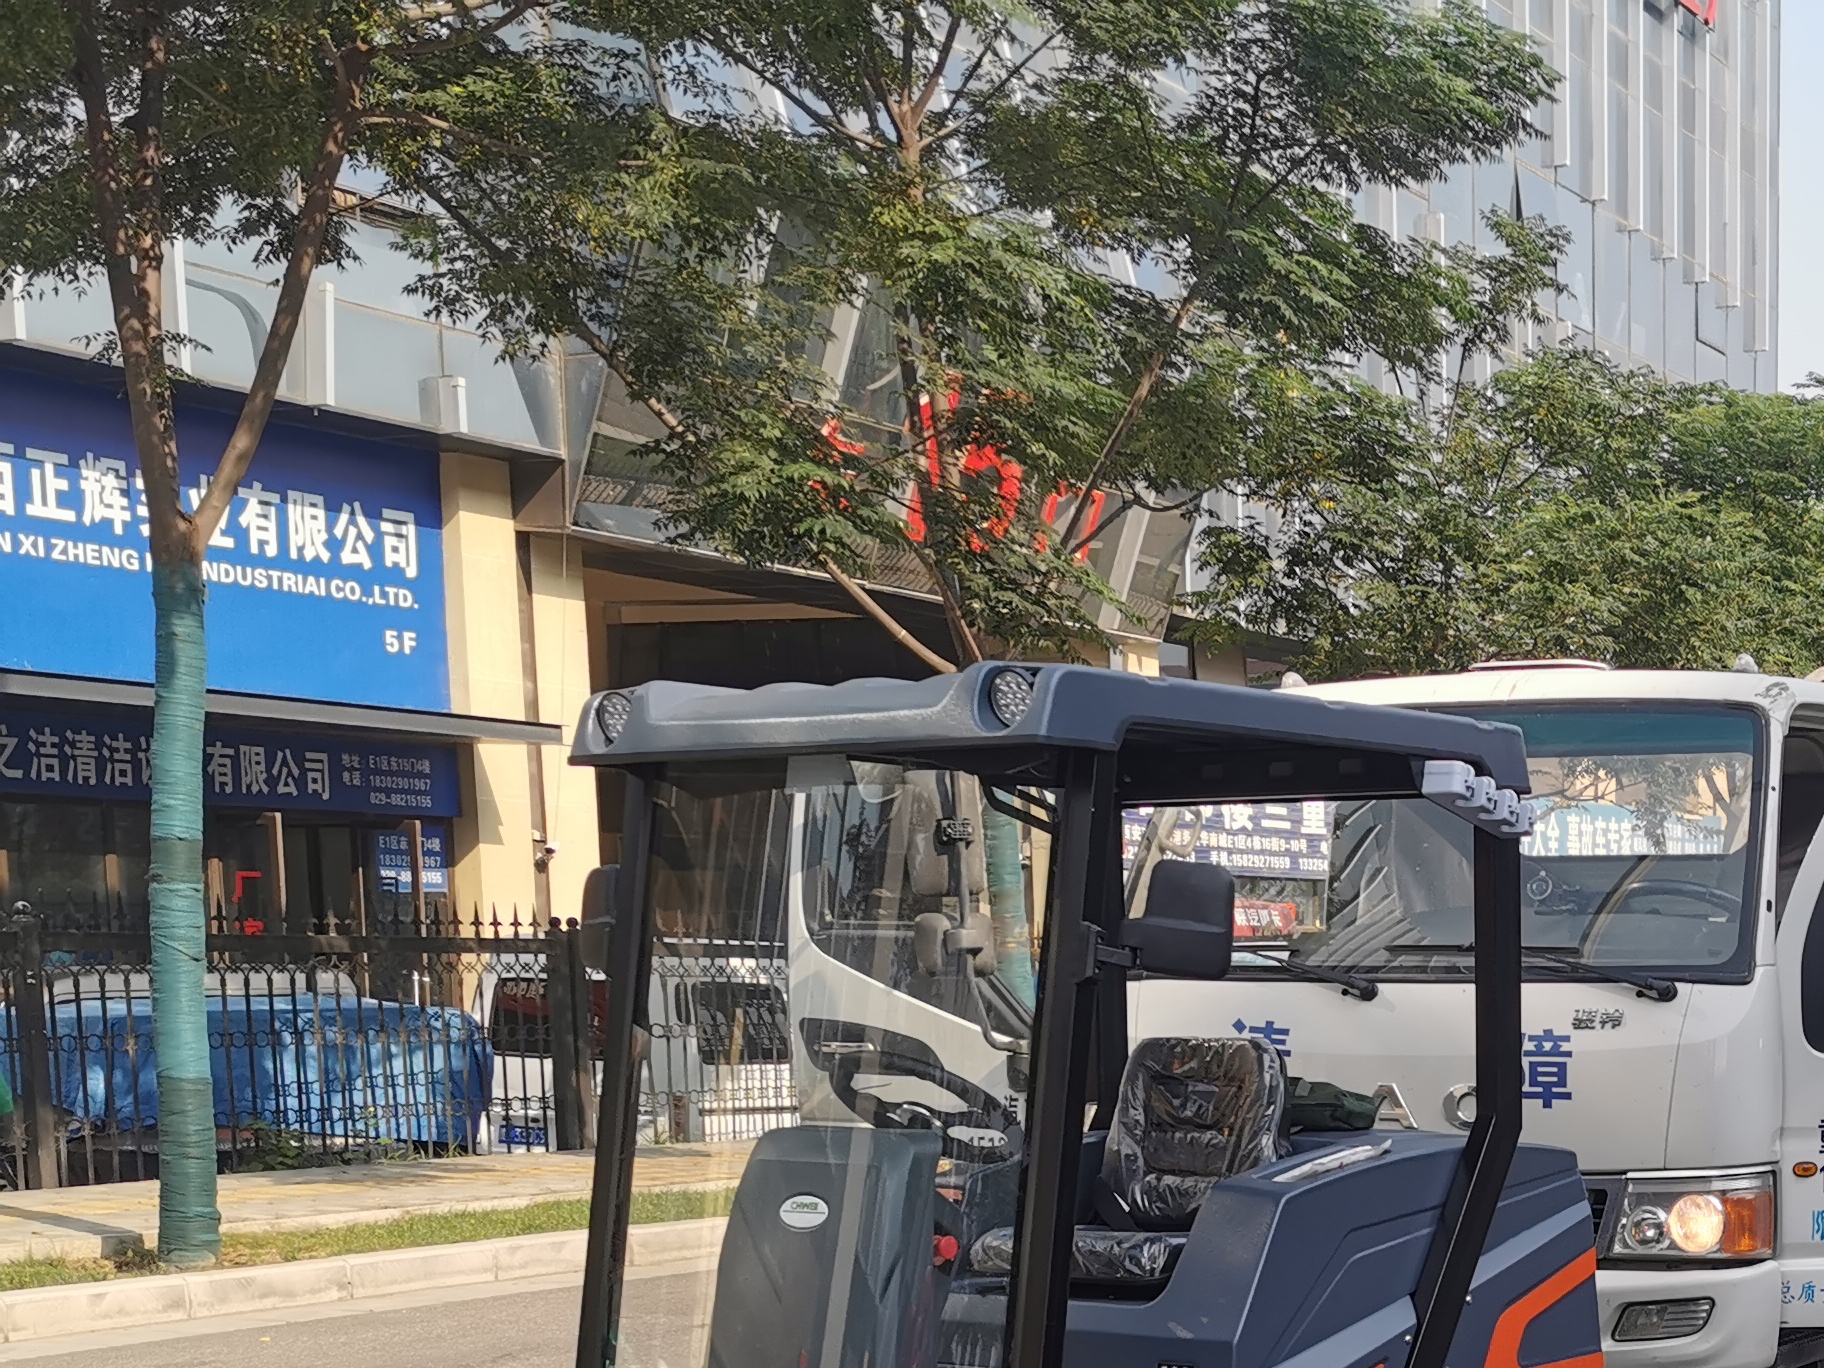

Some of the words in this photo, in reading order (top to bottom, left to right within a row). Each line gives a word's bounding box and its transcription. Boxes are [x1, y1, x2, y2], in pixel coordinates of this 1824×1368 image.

[18, 533, 46, 558] XI
[50, 538, 140, 572] ZHENG
[0, 724, 330, 801] 之洁清洁有限公司
[369, 792, 432, 808] 029-88215155
